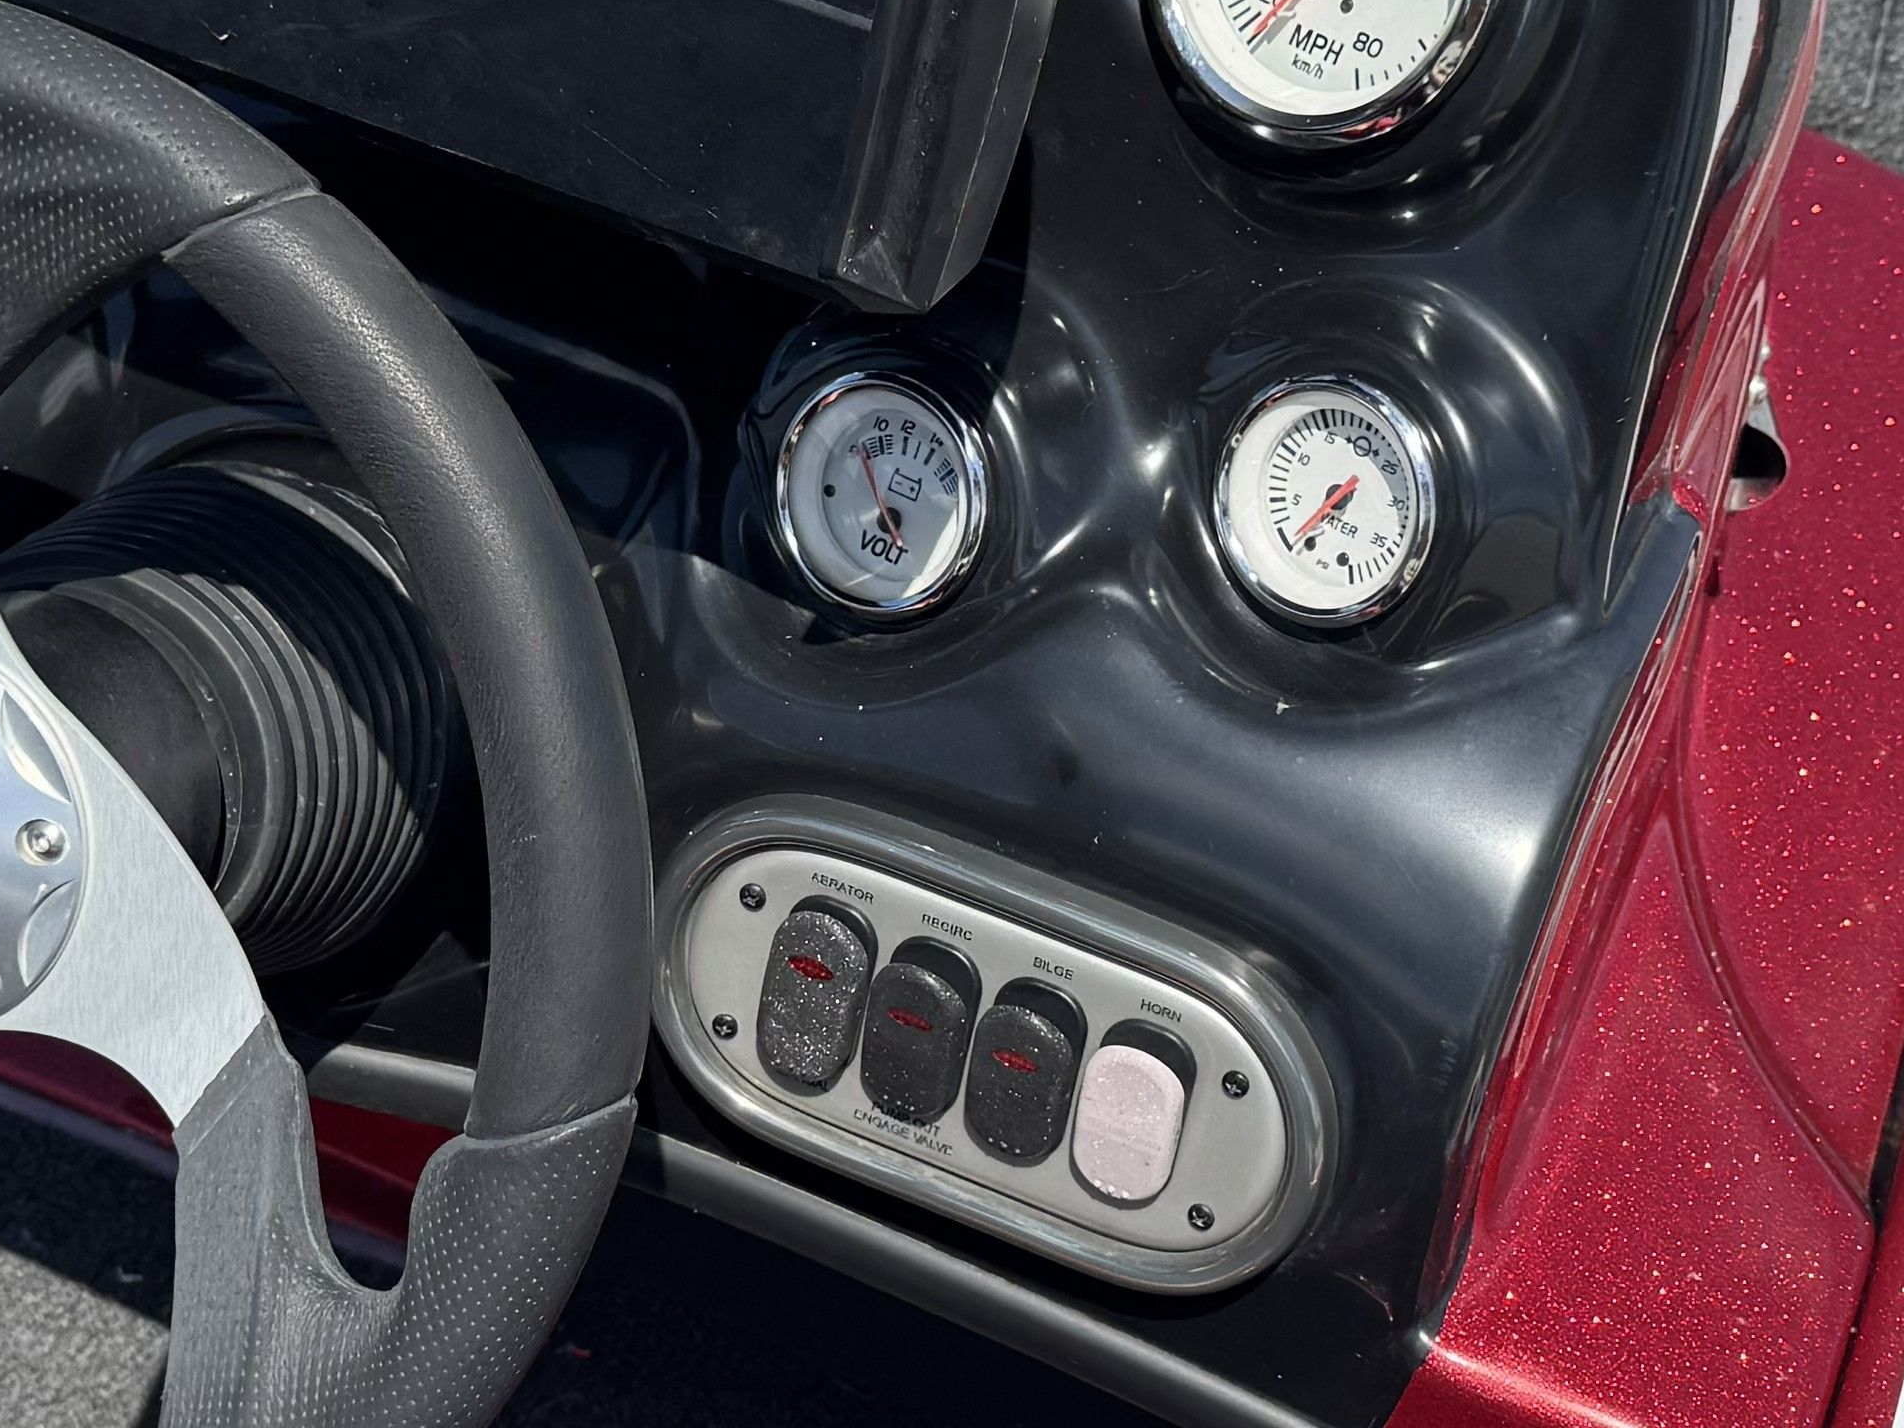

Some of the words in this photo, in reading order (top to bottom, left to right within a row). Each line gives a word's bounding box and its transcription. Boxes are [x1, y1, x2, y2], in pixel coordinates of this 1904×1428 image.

[1288, 23, 1345, 66] MPH
[1352, 31, 1384, 59] 80
[873, 416, 890, 432] 10
[900, 419, 917, 436] 12
[1323, 431, 1337, 445] 15
[1298, 452, 1311, 466] 10
[1381, 460, 1399, 476] 25
[1290, 494, 1303, 507] 5
[1387, 495, 1405, 512] 30
[859, 529, 909, 565] VOLT
[1370, 532, 1388, 549] 35
[811, 872, 875, 905] AERATOR
[921, 913, 974, 941] RECIRC
[1033, 956, 1074, 981] BILGE
[1140, 999, 1182, 1023] HORN
[913, 1131, 953, 1156] VALVE
